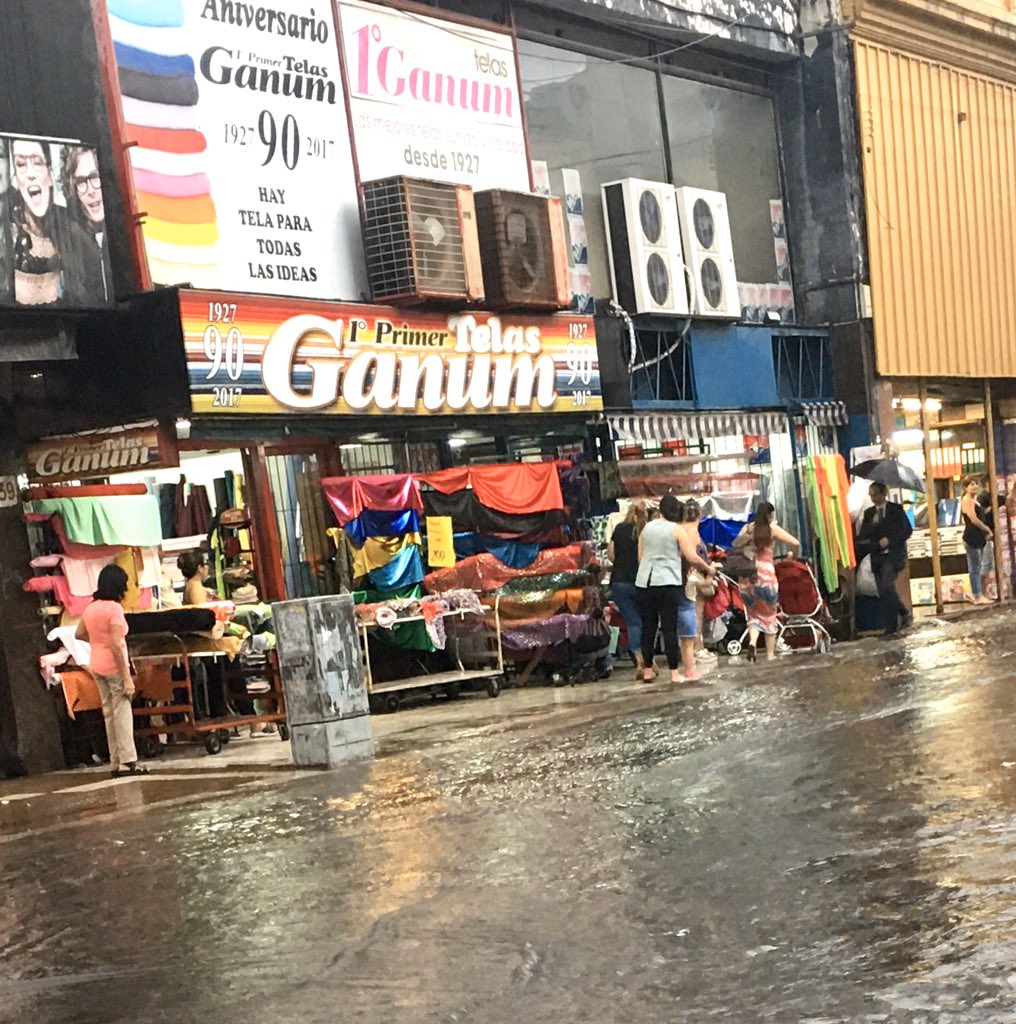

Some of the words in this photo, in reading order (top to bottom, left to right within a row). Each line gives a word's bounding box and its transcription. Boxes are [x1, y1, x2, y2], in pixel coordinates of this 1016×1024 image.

[200, 0, 329, 44] Aniversario
[200, 46, 337, 105] Ganum
[282, 55, 329, 78] Telas
[474, 49, 508, 78] telas
[376, 46, 513, 118] Ganum
[223, 123, 255, 147] 1927
[258, 109, 300, 171] 90
[306, 136, 335, 159] 2017
[403, 145, 448, 170] desde
[451, 151, 480, 175] 1927
[258, 186, 286, 205] HAY
[238, 209, 275, 229] TELA
[276, 213, 313, 232] PARA
[256, 238, 302, 257] TODAS
[248, 262, 275, 280] LAS
[276, 265, 318, 283] IDEAS
[208, 302, 237, 323] 1927
[375, 320, 449, 347] Primer
[449, 314, 541, 353] Telas
[568, 322, 588, 340] 1927
[203, 325, 244, 381] 90
[261, 314, 557, 411] Ganum
[566, 342, 593, 386] 90
[212, 386, 242, 408] 2017
[572, 390, 592, 407] 2017
[103, 437, 143, 450] Telas
[36, 447, 150, 476] Ganum
